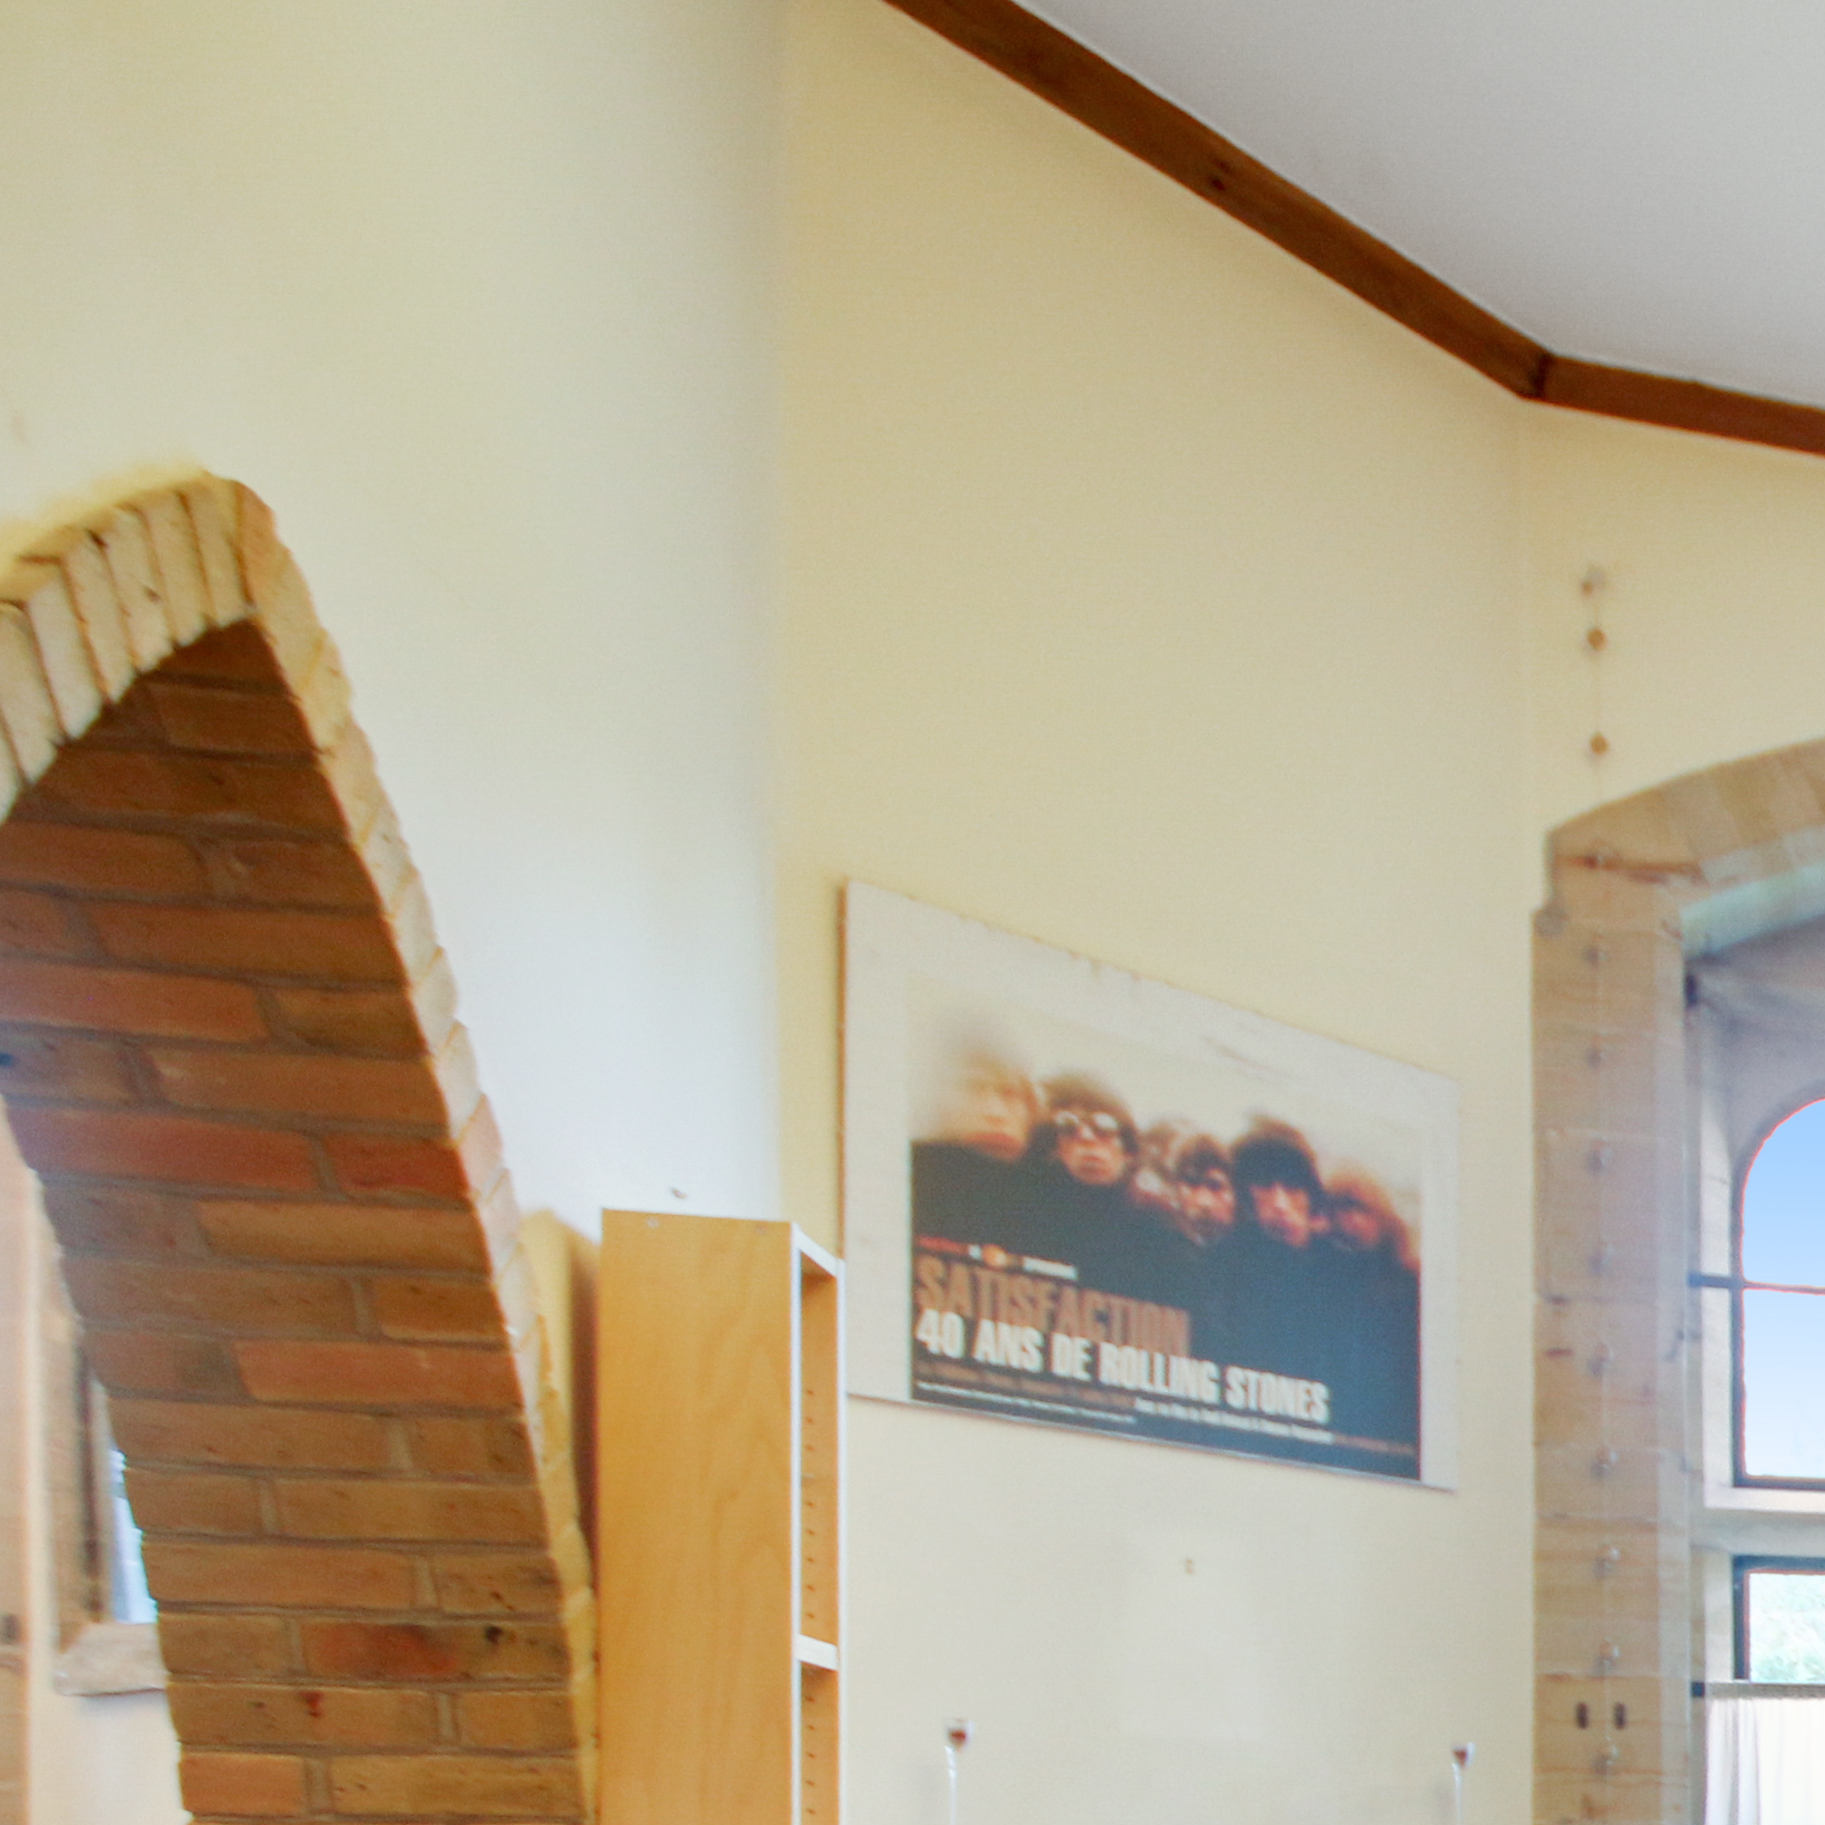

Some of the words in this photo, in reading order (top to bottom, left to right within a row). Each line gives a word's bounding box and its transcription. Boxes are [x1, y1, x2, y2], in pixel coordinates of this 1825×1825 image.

[915, 1308, 966, 1360] 40
[972, 1317, 1045, 1374] ANS
[1050, 1331, 1095, 1382] DE
[1099, 1340, 1220, 1406] ROLLING
[1225, 1364, 1331, 1426] STONES
